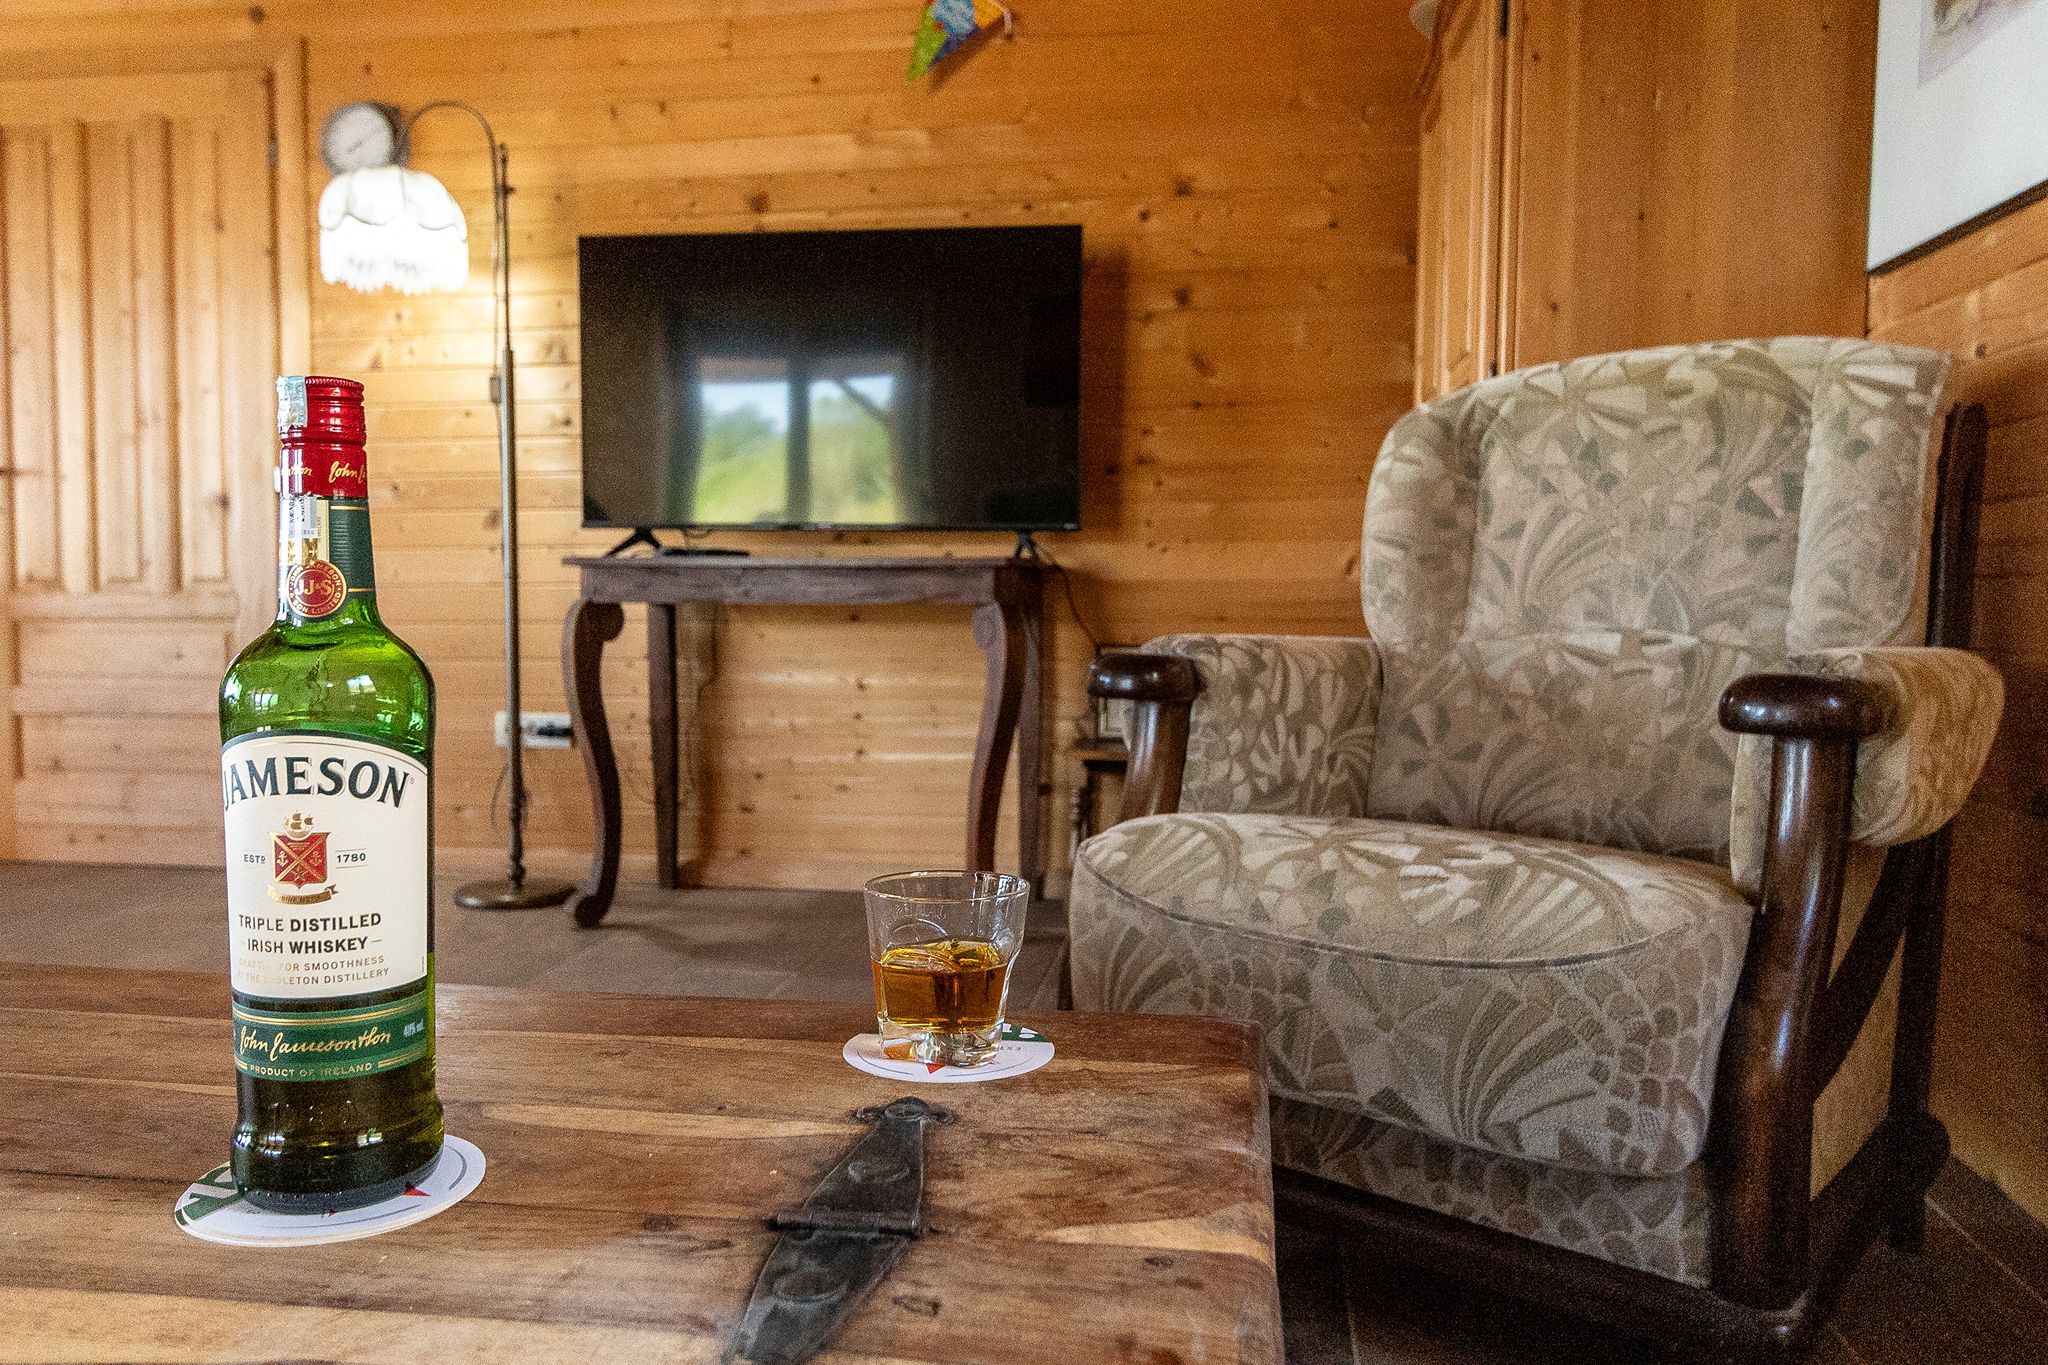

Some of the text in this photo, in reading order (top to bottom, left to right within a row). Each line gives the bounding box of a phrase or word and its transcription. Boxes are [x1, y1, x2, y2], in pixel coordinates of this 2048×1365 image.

[328, 461, 358, 483] John
[223, 756, 410, 812] JAMESON
[336, 852, 367, 864] 1780
[238, 912, 382, 932] TRIPLE DISTILLED
[247, 936, 368, 954] IRISH WHISKEY
[303, 955, 385, 972] SMOOTHNESS
[324, 967, 390, 984] DISTILLERY
[240, 1026, 268, 1055] John
[250, 1062, 373, 1077] PRODUCT OF IRELAND
